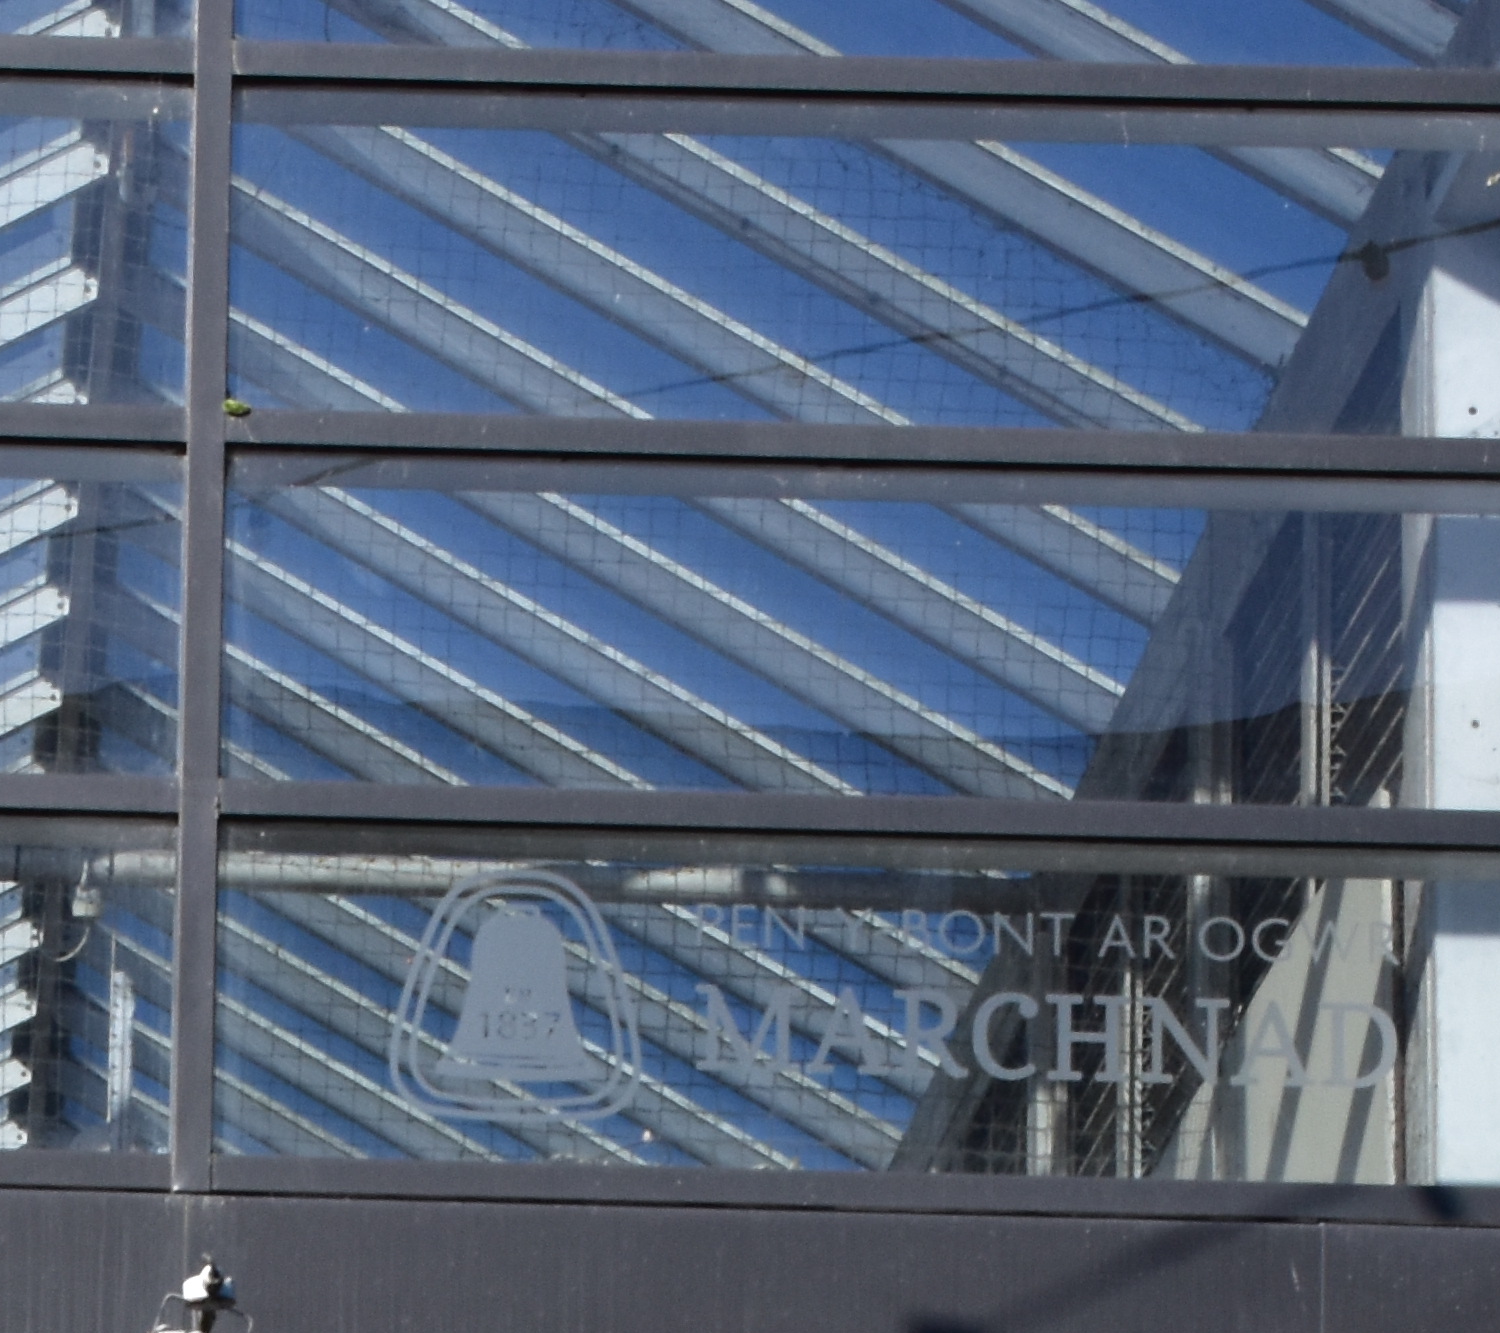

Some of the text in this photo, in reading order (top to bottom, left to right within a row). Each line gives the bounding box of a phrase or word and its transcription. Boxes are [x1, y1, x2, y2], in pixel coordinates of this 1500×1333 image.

[1097, 914, 1176, 960] AR
[1200, 915, 1399, 967] OGWR
[694, 982, 1400, 1091] MARCHNAD
